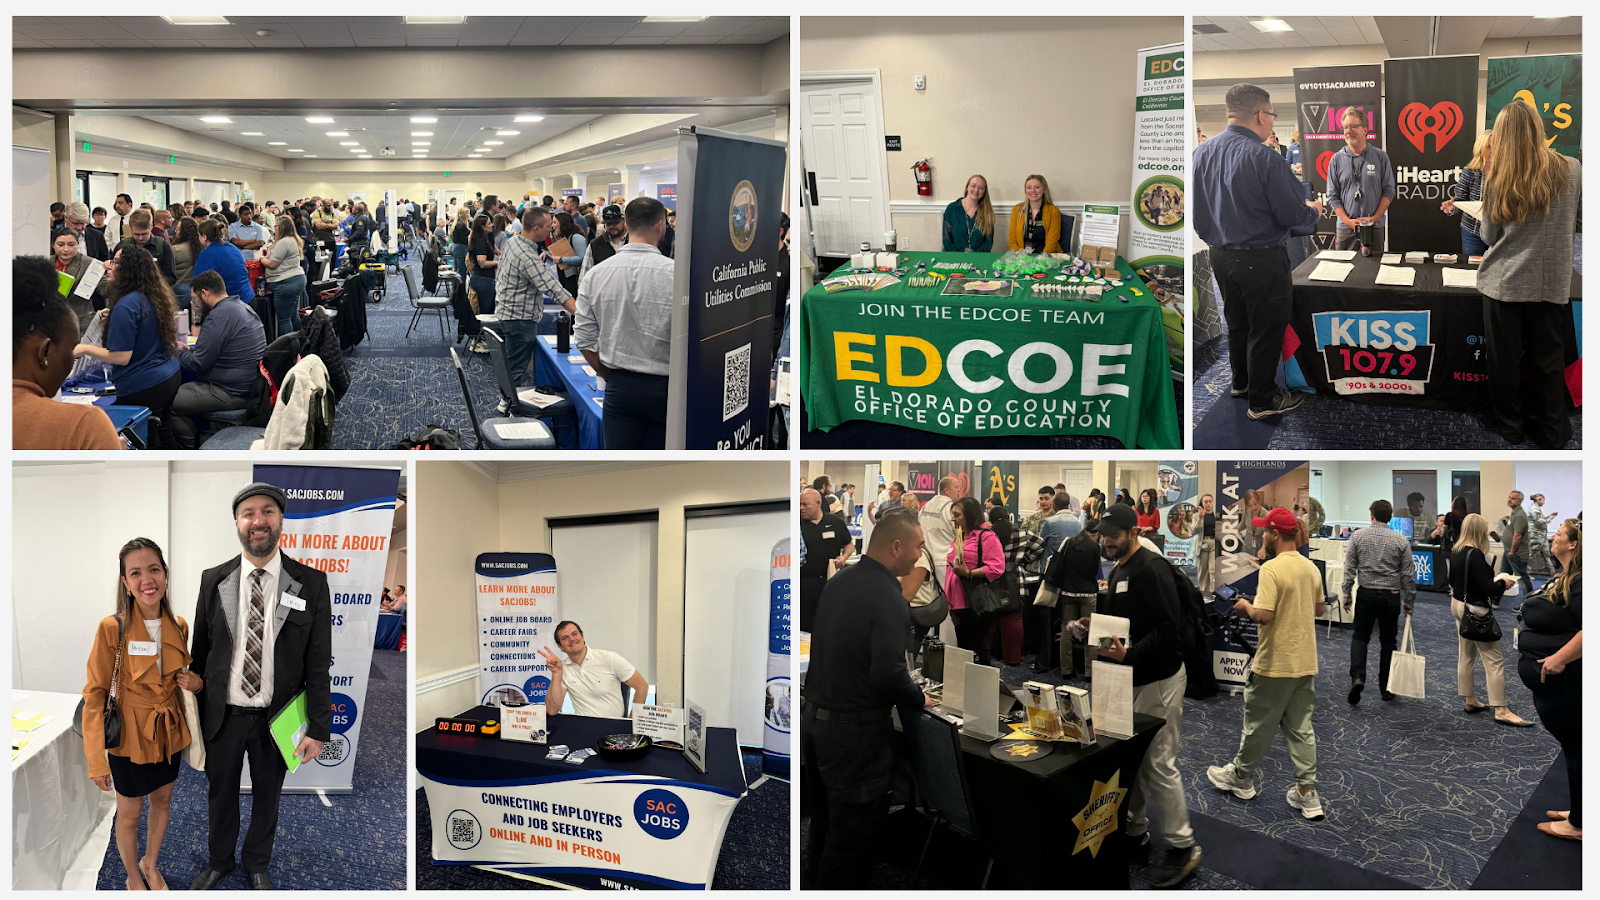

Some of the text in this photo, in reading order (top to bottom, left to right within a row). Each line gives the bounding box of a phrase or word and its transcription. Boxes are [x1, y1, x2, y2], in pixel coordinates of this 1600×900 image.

[1299, 80, 1376, 90] @V1011SACRAMENTO
[712, 258, 766, 282] California Public
[705, 289, 734, 308] Utilities
[735, 280, 772, 300] Commission
[858, 303, 1104, 324] JOIN THE EDCOE TEAM
[1331, 317, 1416, 352] KISS
[833, 331, 1132, 398] EDCOE
[1340, 349, 1416, 376] 107.9
[1378, 383, 1412, 391] 2000s
[855, 385, 1111, 414] EL DORADO COUNTY
[854, 400, 1110, 430] OFFICE OF EDUCATION
[734, 419, 750, 450] YOU
[1221, 472, 1240, 574] WORK AT
[302, 534, 338, 550] MORE
[342, 536, 386, 550] ABOUT
[334, 593, 372, 604] BOARD
[479, 584, 555, 594] LEARN MORE ABOUT
[500, 598, 536, 606] SACJOBS!
[1220, 658, 1244, 666] APPLY
[1224, 667, 1244, 676] NOW
[482, 792, 622, 828] CONNECTING EMPLOYERS
[646, 800, 676, 814] SAC
[1083, 792, 1120, 820] SHERIFF'S
[502, 813, 602, 842] AND JOB SEEKERS
[641, 814, 680, 830] JOBS
[1084, 815, 1114, 836] OFFICE
[490, 828, 621, 865] ONLINE AND IN PERSON
